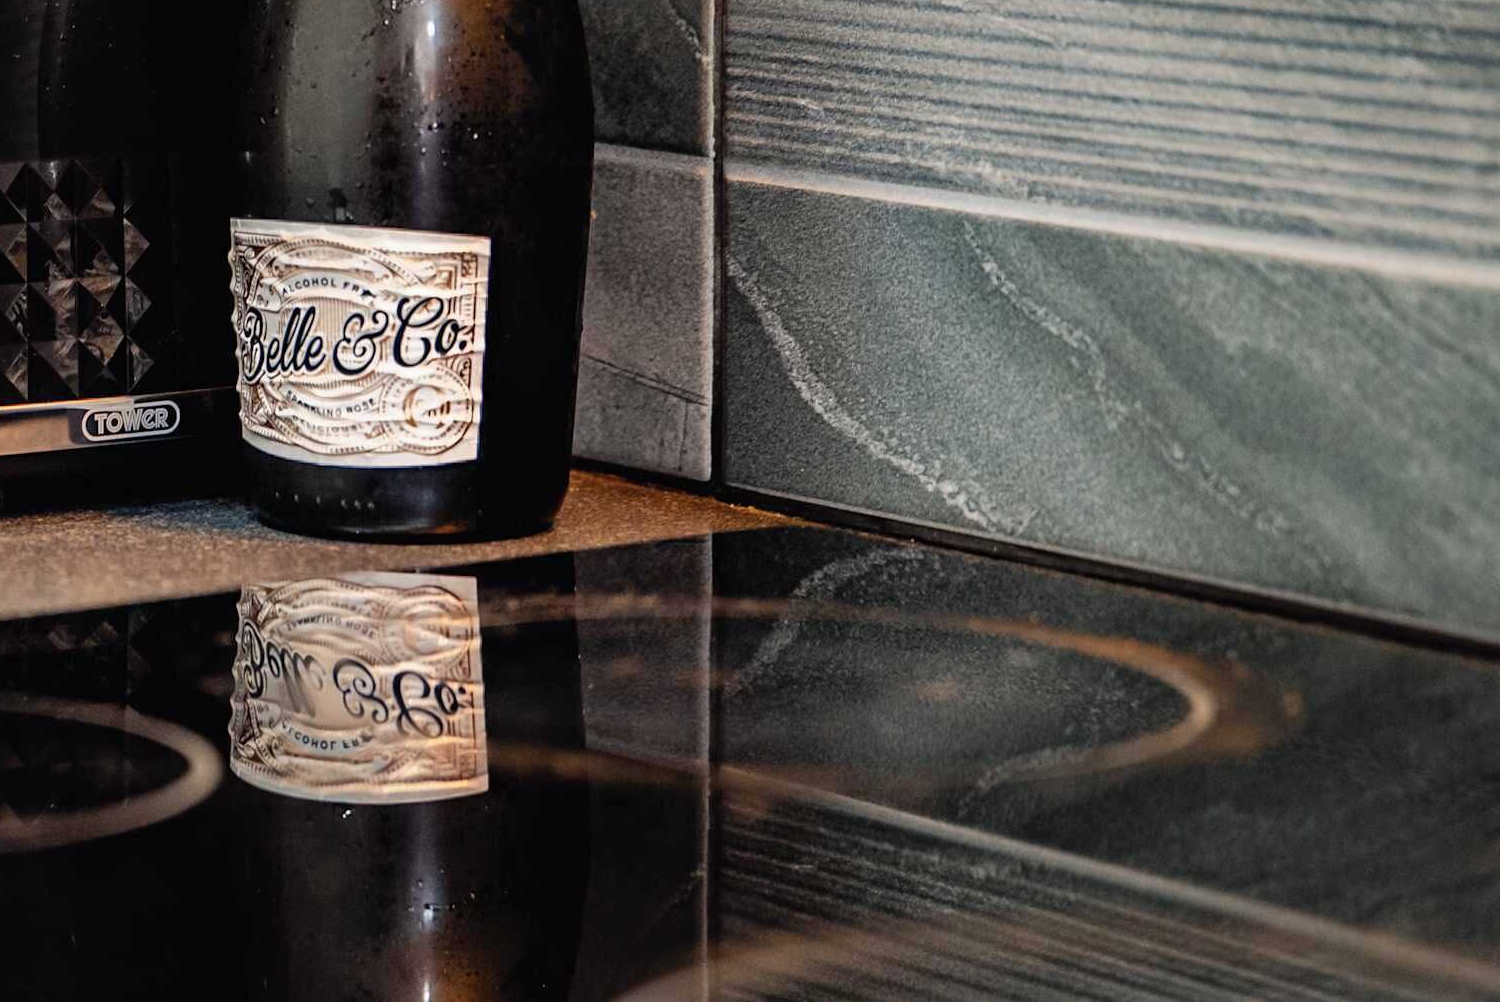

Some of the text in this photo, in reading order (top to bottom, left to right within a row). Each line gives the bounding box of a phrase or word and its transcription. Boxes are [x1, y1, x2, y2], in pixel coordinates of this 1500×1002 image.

[282, 277, 337, 296] ALCOHOL
[243, 296, 468, 383] Belle & Co.
